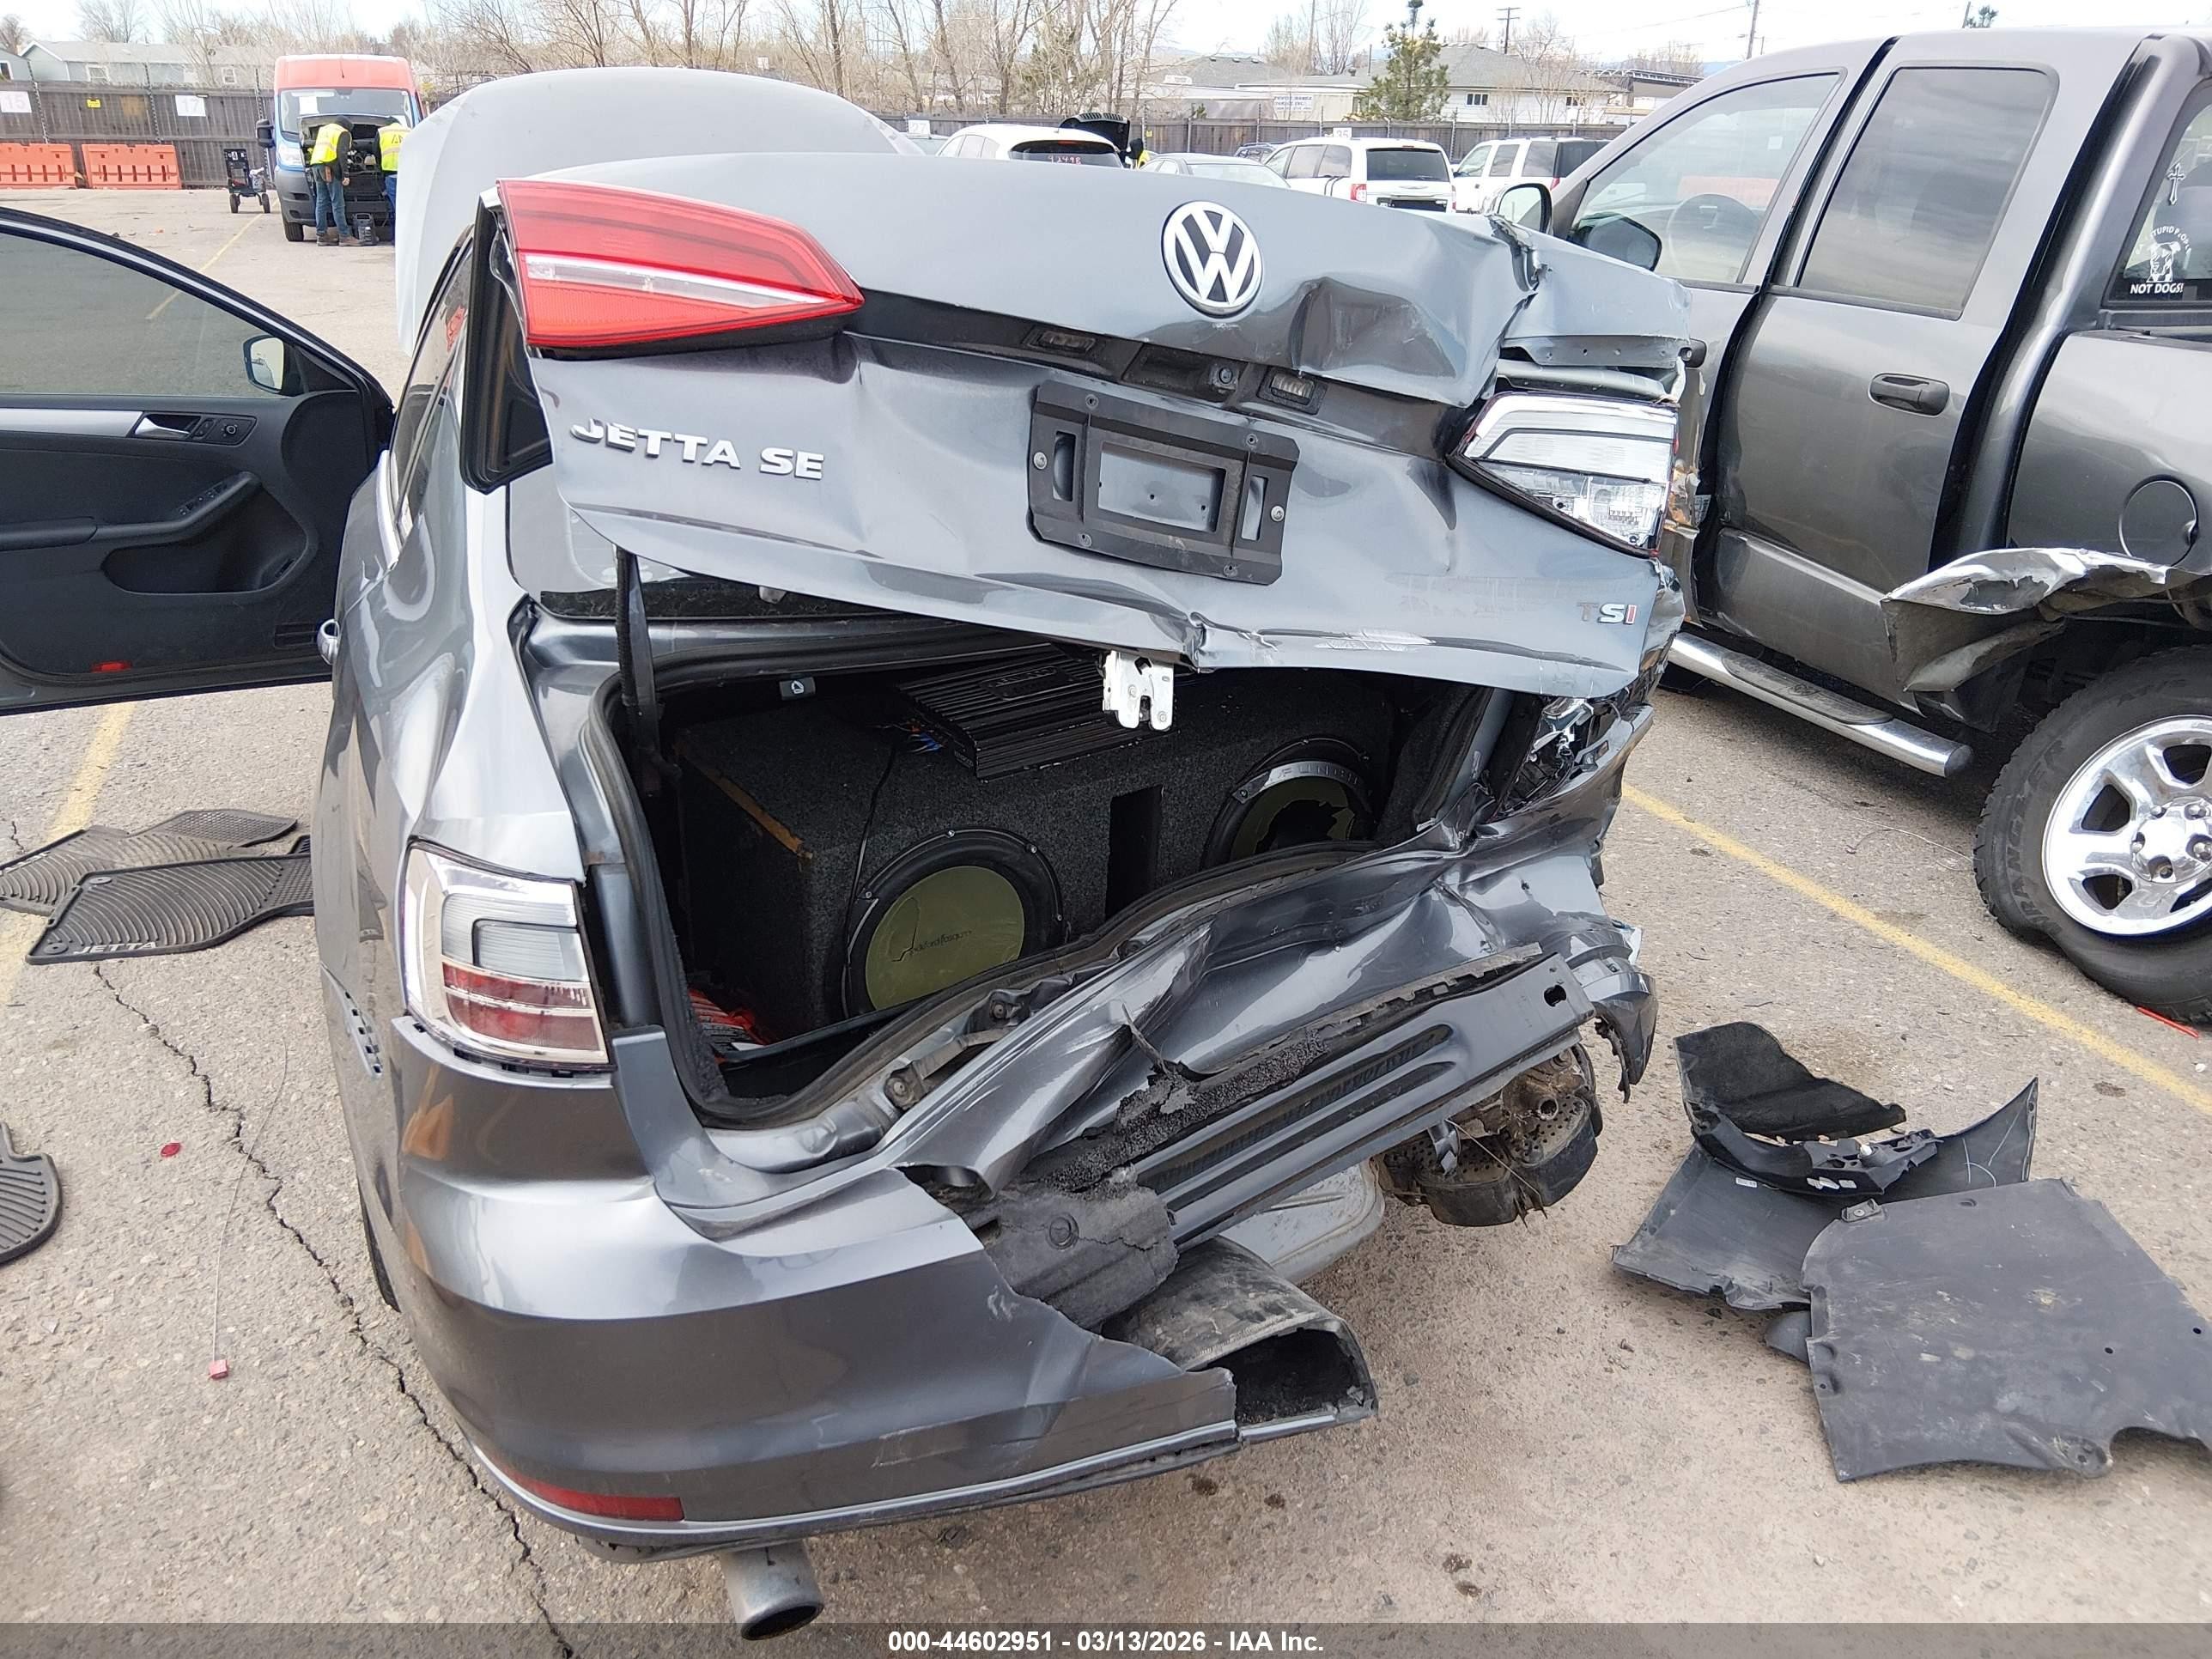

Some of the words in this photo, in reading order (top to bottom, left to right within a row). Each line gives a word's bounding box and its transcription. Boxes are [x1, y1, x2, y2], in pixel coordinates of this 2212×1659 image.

[181, 96, 200, 113] 17
[909, 122, 927, 133] 27
[2130, 283, 2154, 294] NOT
[2154, 283, 2185, 294] DOGS!
[570, 418, 741, 470] JETTA
[759, 447, 824, 480] SE
[73, 942, 156, 954] JETTA
